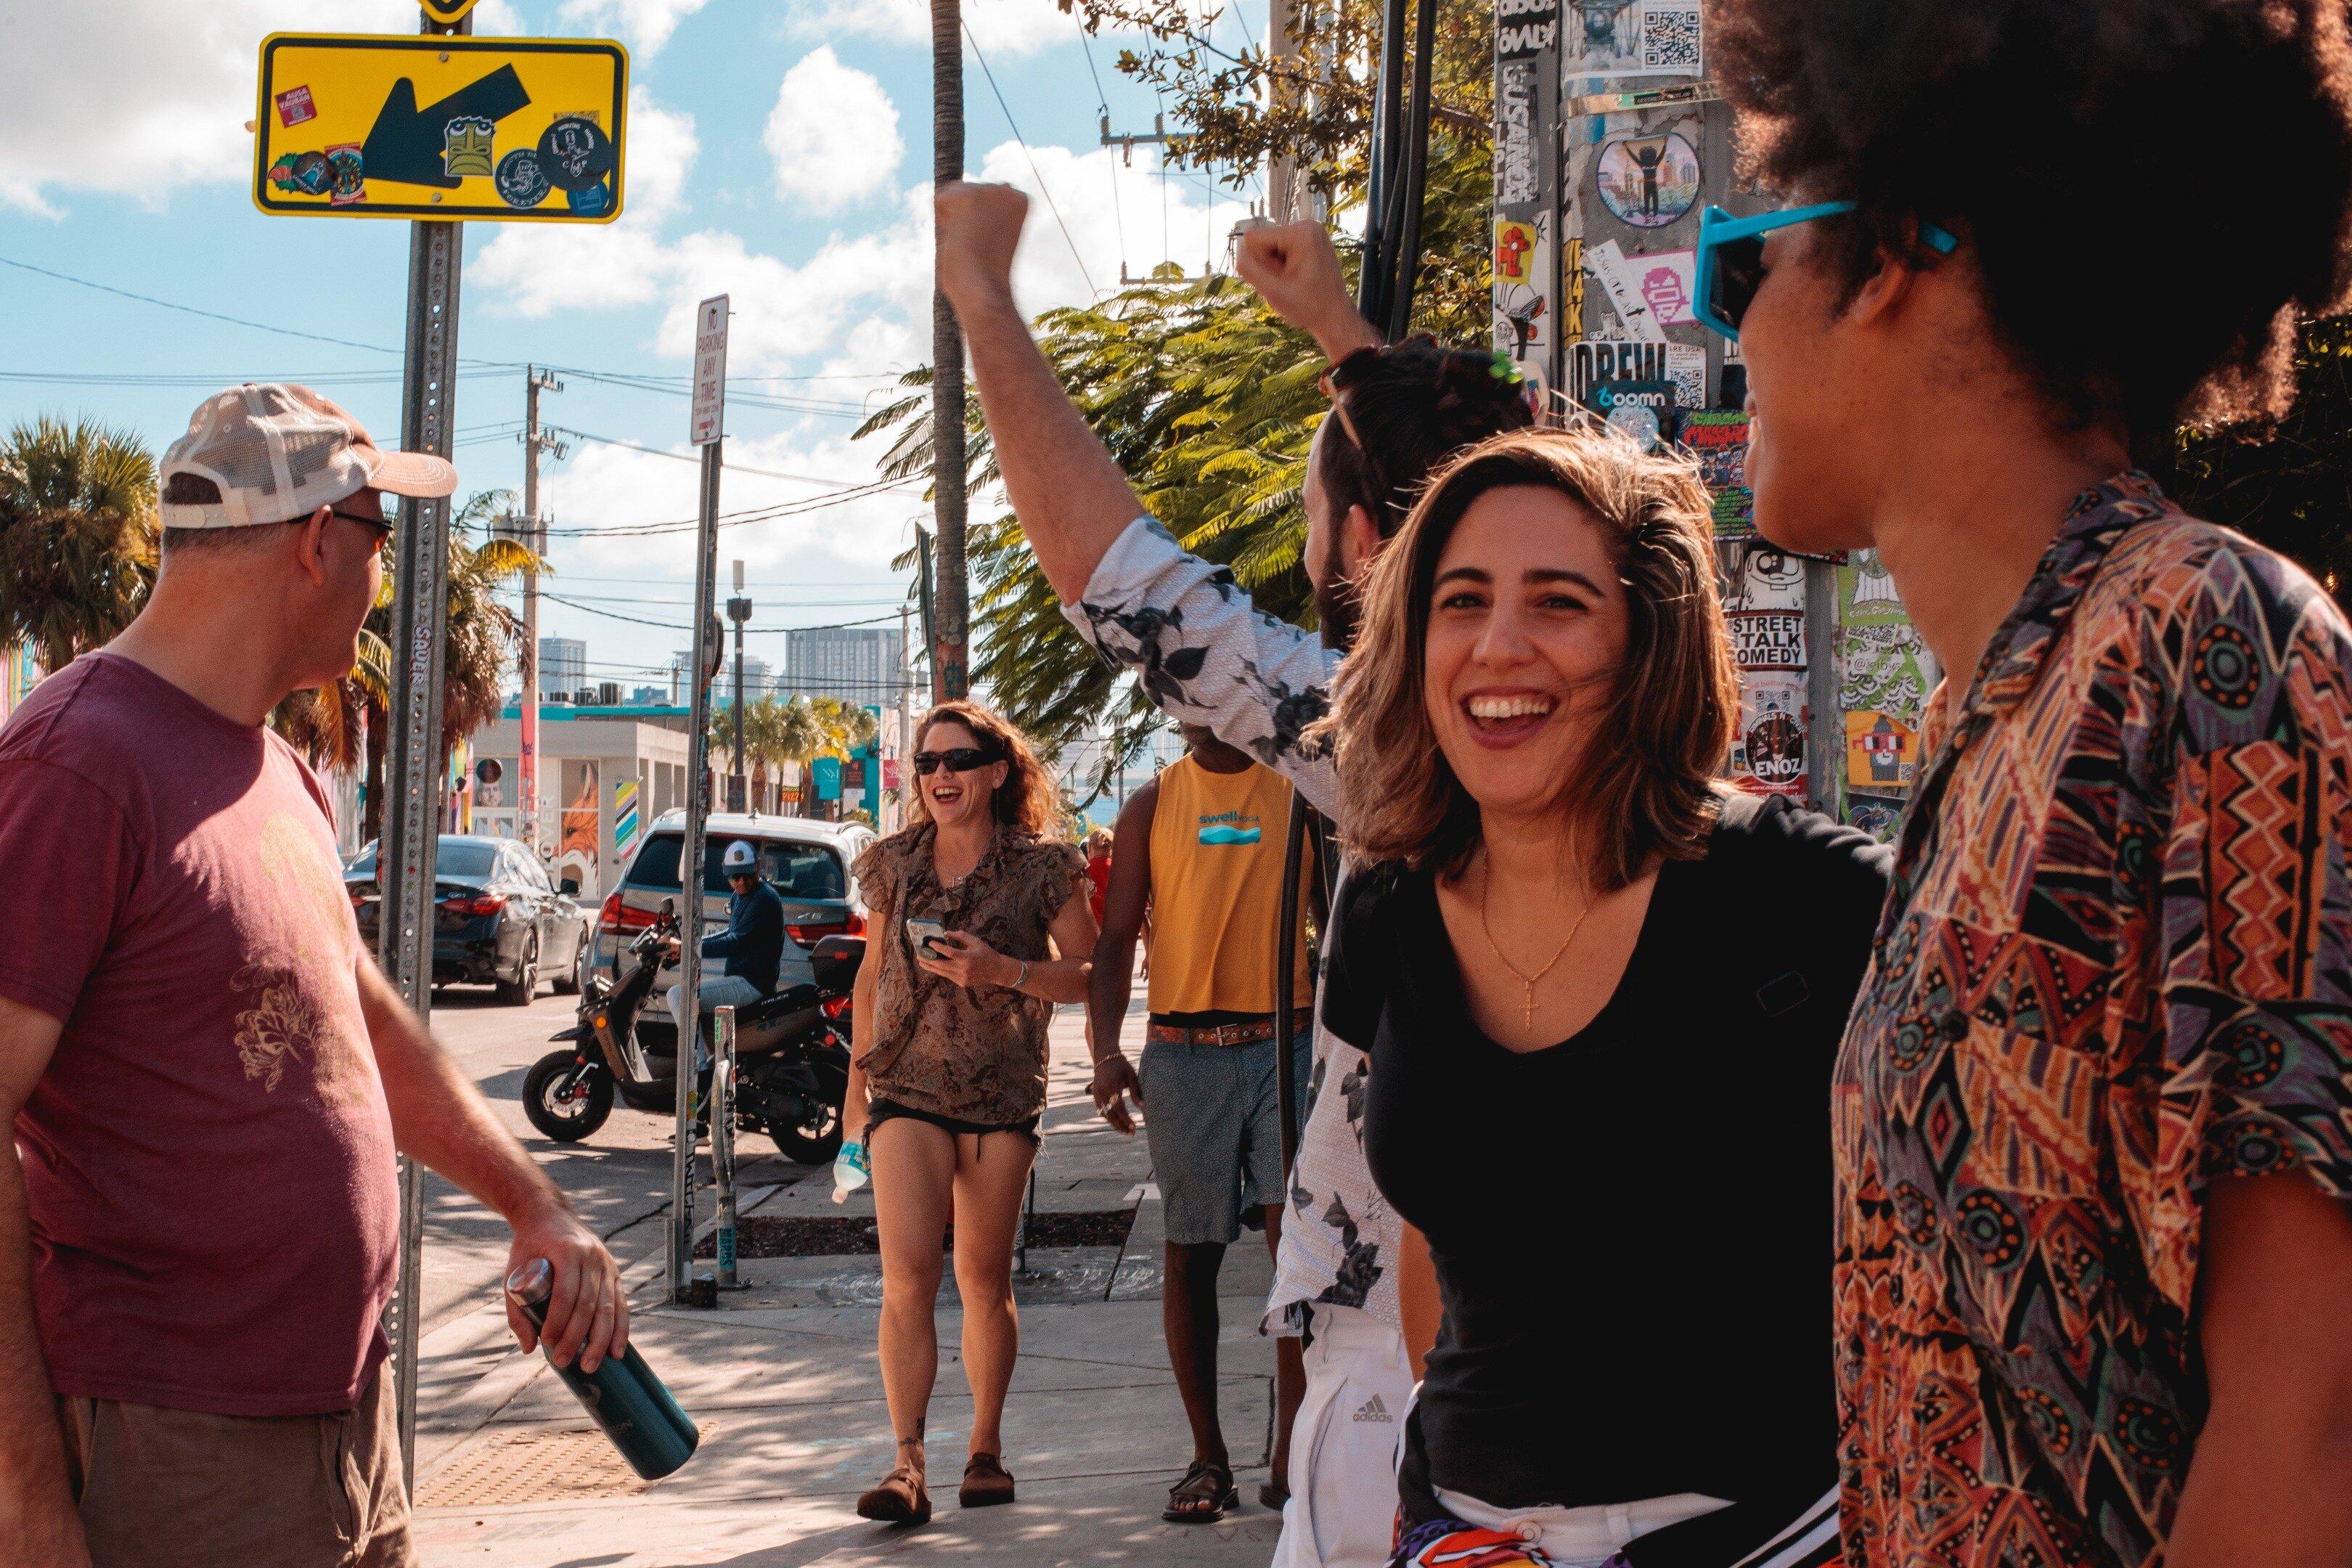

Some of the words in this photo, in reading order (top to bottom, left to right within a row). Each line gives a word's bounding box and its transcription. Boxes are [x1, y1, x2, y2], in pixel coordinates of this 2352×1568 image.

[707, 307, 717, 330] NO
[698, 331, 724, 355] PARKING
[703, 356, 716, 378] ANY
[701, 380, 716, 402] TIME
[1733, 616, 1801, 633] STREET
[1740, 632, 1801, 648] TALK
[1755, 758, 1800, 777] ENOZ
[1352, 1411, 1393, 1423] adidas
